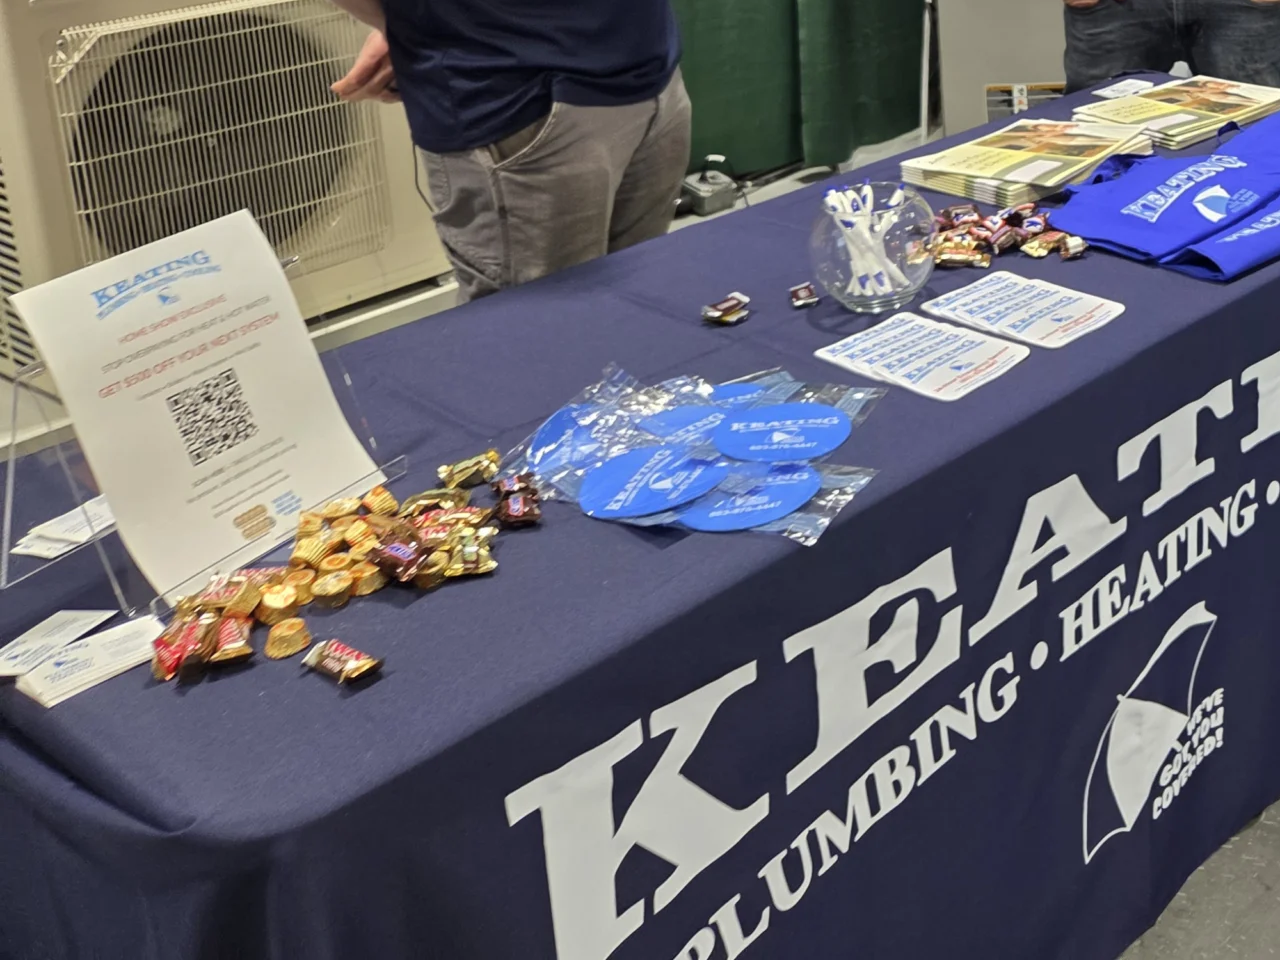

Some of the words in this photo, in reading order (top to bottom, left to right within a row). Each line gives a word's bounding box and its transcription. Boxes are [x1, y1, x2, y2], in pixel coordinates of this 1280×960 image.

[1120, 153, 1248, 224] KEATING
[90, 249, 212, 309] KEATING
[902, 339, 977, 380] KEATING
[730, 416, 841, 431] KEATING
[1058, 478, 1259, 662] HEATING
[1191, 706, 1225, 749] YOU
[1152, 726, 1224, 820] COVERED!
